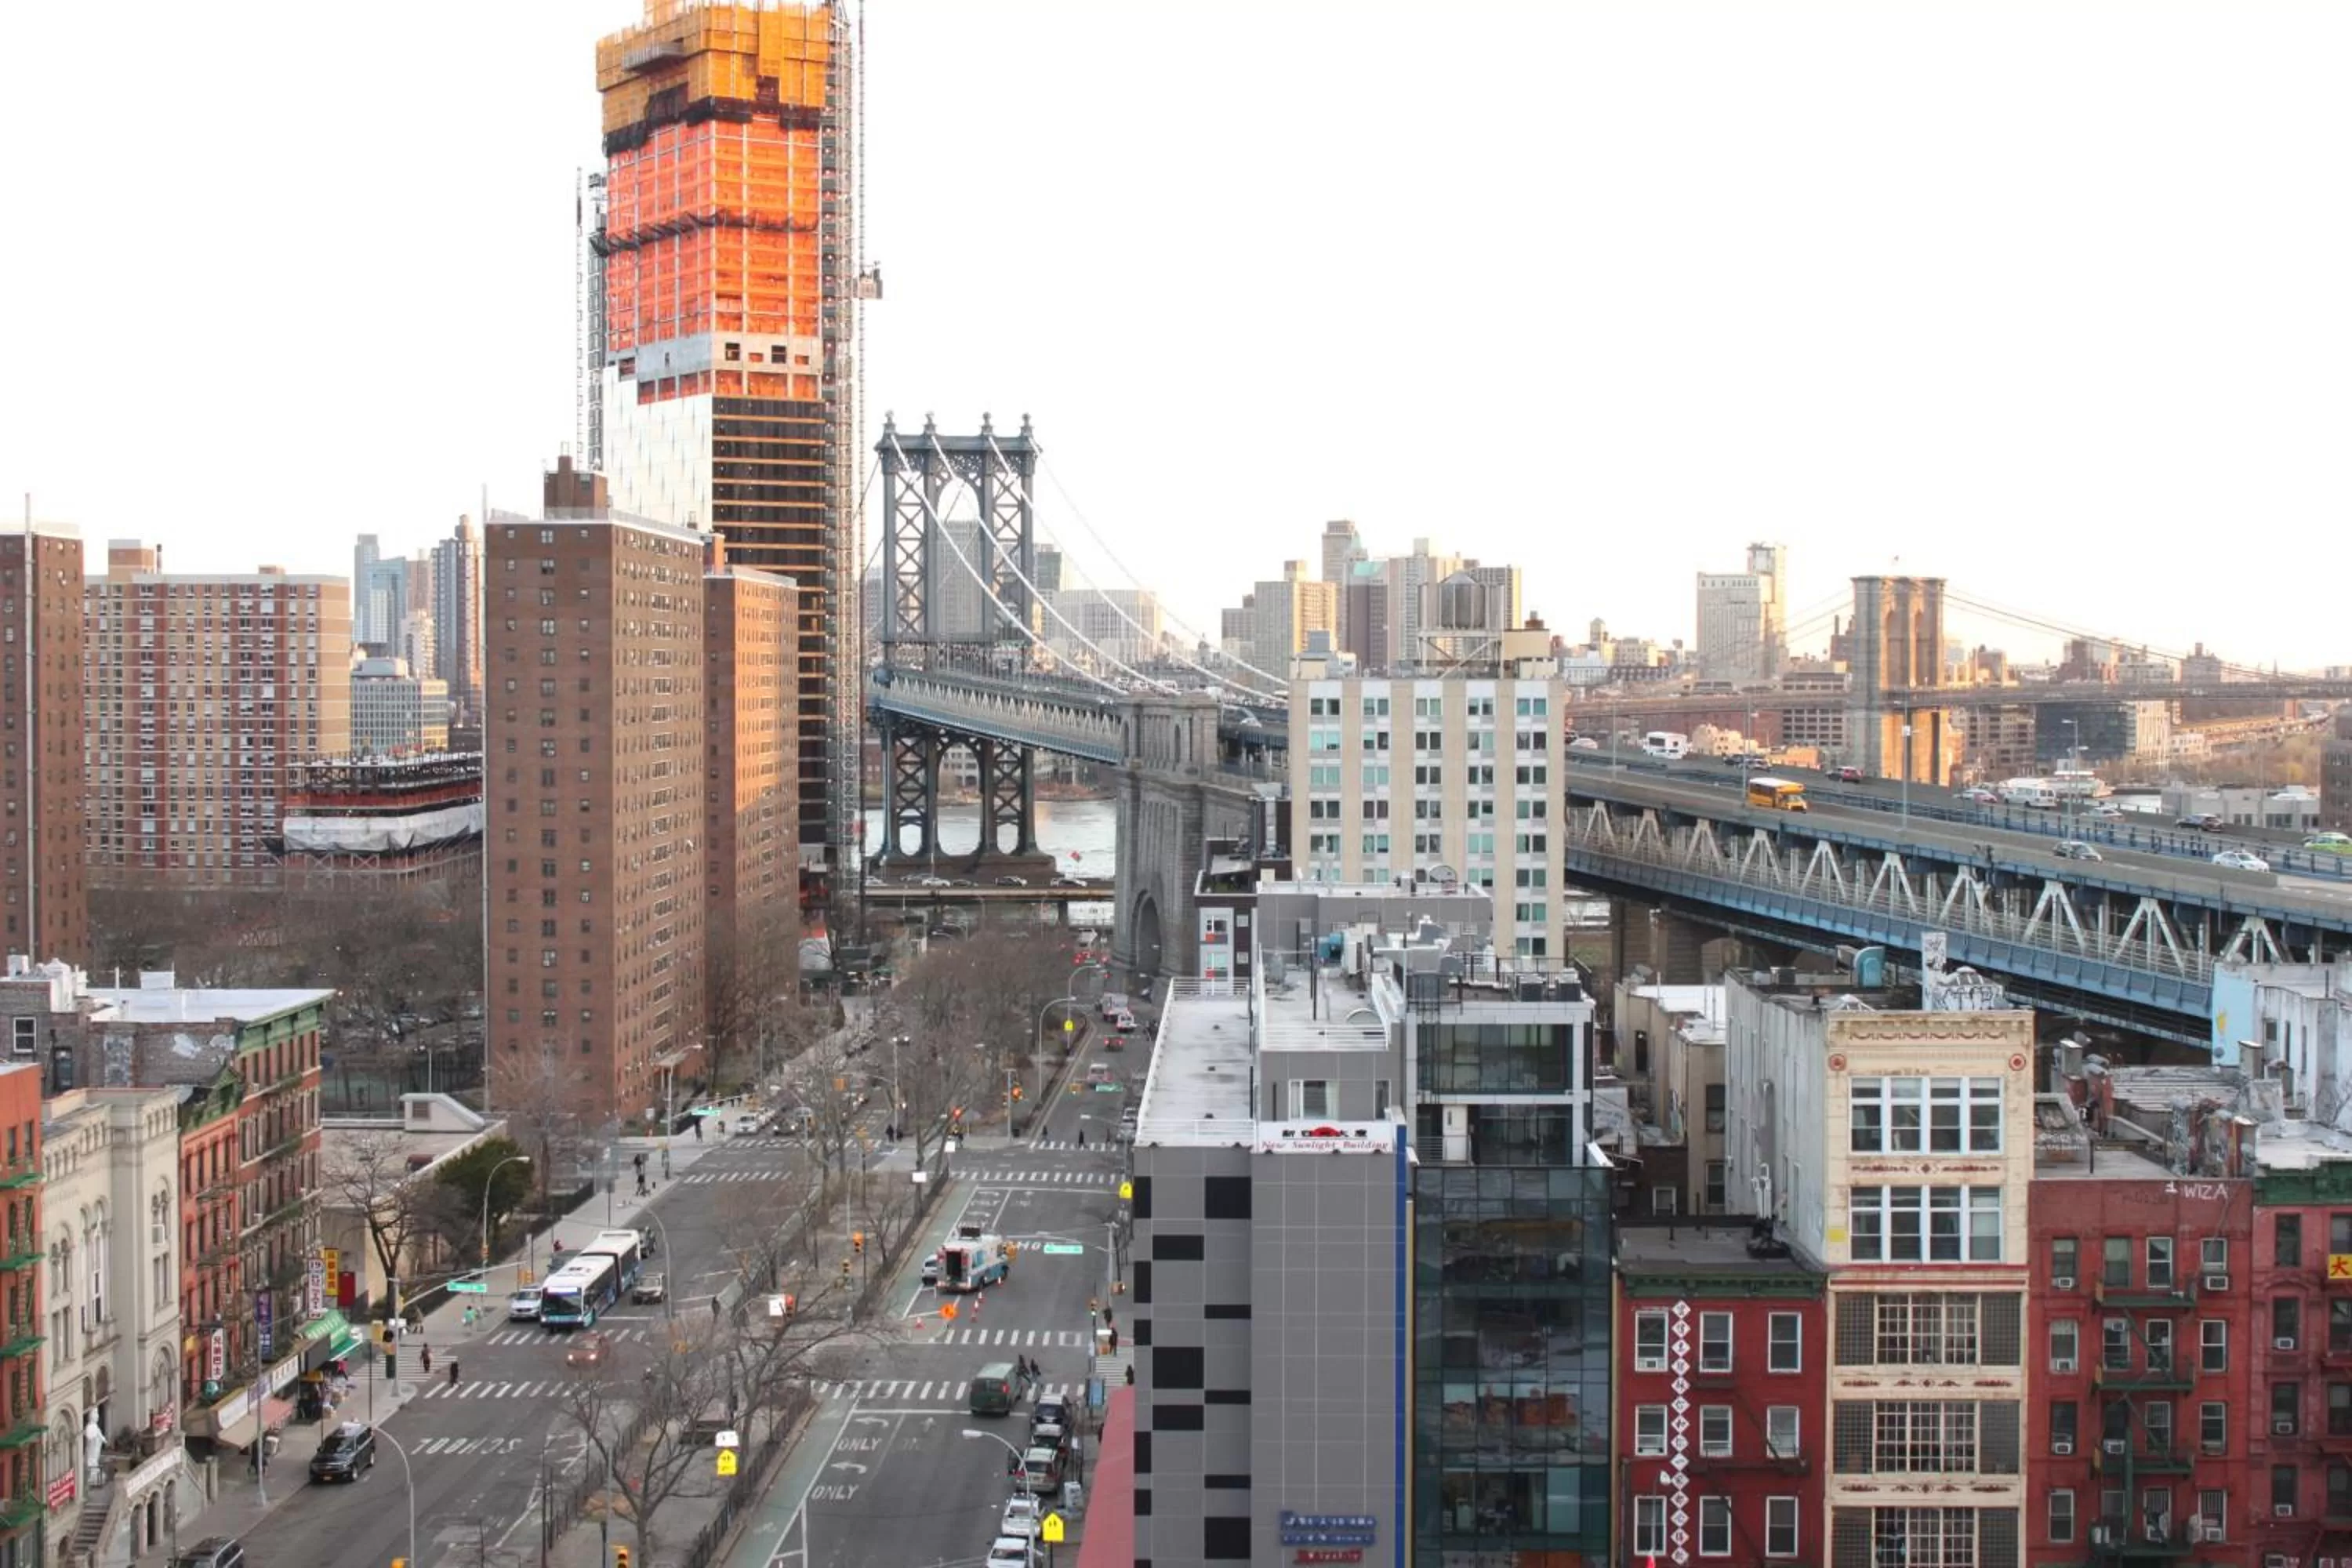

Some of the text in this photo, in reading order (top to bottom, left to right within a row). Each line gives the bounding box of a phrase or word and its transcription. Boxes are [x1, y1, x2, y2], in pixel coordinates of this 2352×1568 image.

[1261, 1141, 1388, 1150] New Sunlight Building
[2330, 1256, 2350, 1276] 大
[837, 1437, 883, 1451] ONLY
[811, 1484, 860, 1500] ONLY
